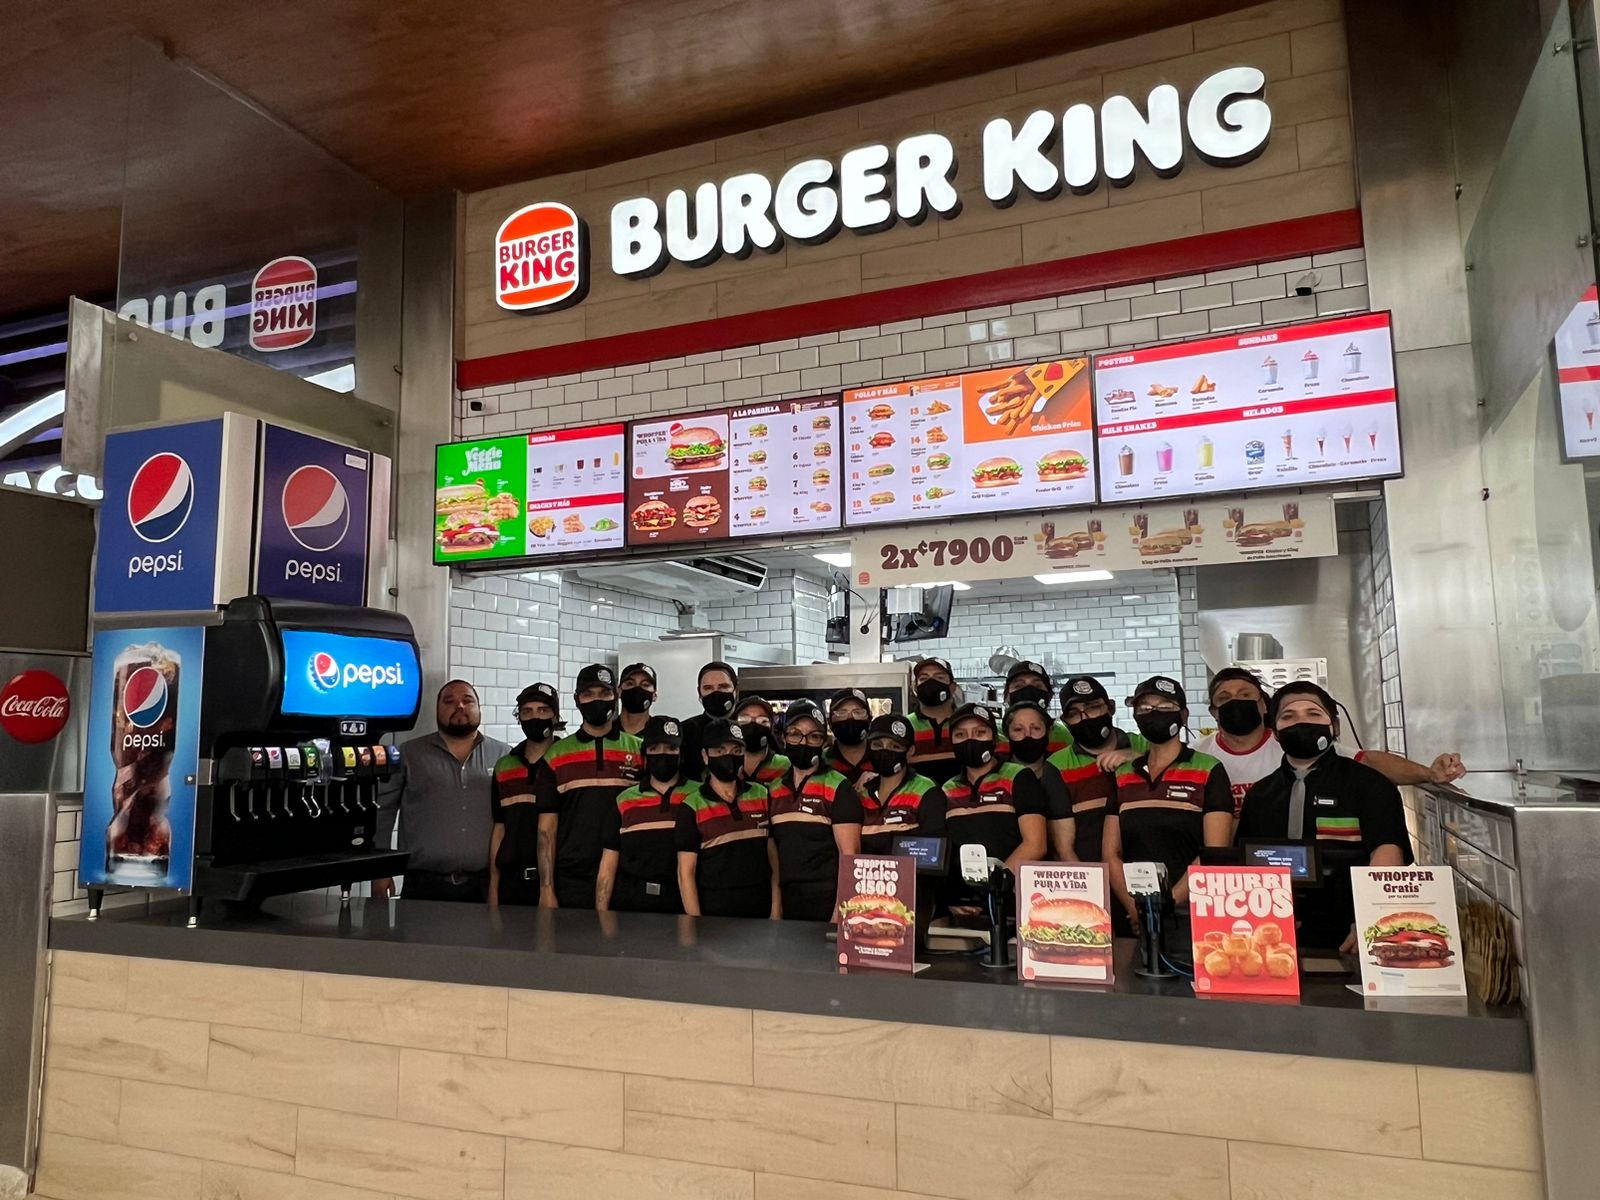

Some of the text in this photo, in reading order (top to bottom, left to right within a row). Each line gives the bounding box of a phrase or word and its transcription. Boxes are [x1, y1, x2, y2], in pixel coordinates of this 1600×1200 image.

[611, 66, 1273, 276] BURGER KING
[500, 231, 575, 264] BURGER
[500, 251, 575, 291] KING
[1099, 355, 1135, 367] POSTRES
[854, 390, 876, 399] POLLO
[733, 404, 780, 418] A LA PARRILLA
[1243, 405, 1284, 418] HELADOS
[1031, 420, 1082, 432] Chicken Fries
[1102, 422, 1157, 435] MILK SHAKES
[465, 446, 503, 462] Veggie
[793, 452, 798, 460] 6
[912, 494, 922, 502] 16
[793, 507, 799, 515] 8
[128, 550, 183, 578] pepsi
[285, 559, 342, 584] pepsi
[343, 663, 402, 690] pepsi
[1, 694, 67, 719] Coca-Cola
[123, 731, 164, 751] pepsi
[853, 858, 899, 869] WHOPPER
[1033, 870, 1087, 880] WHOPPER
[1368, 871, 1434, 881] WHOPPER
[1034, 880, 1060, 890] PURA
[1188, 872, 1293, 896] CHURRI
[1189, 887, 1293, 918] TICOS
